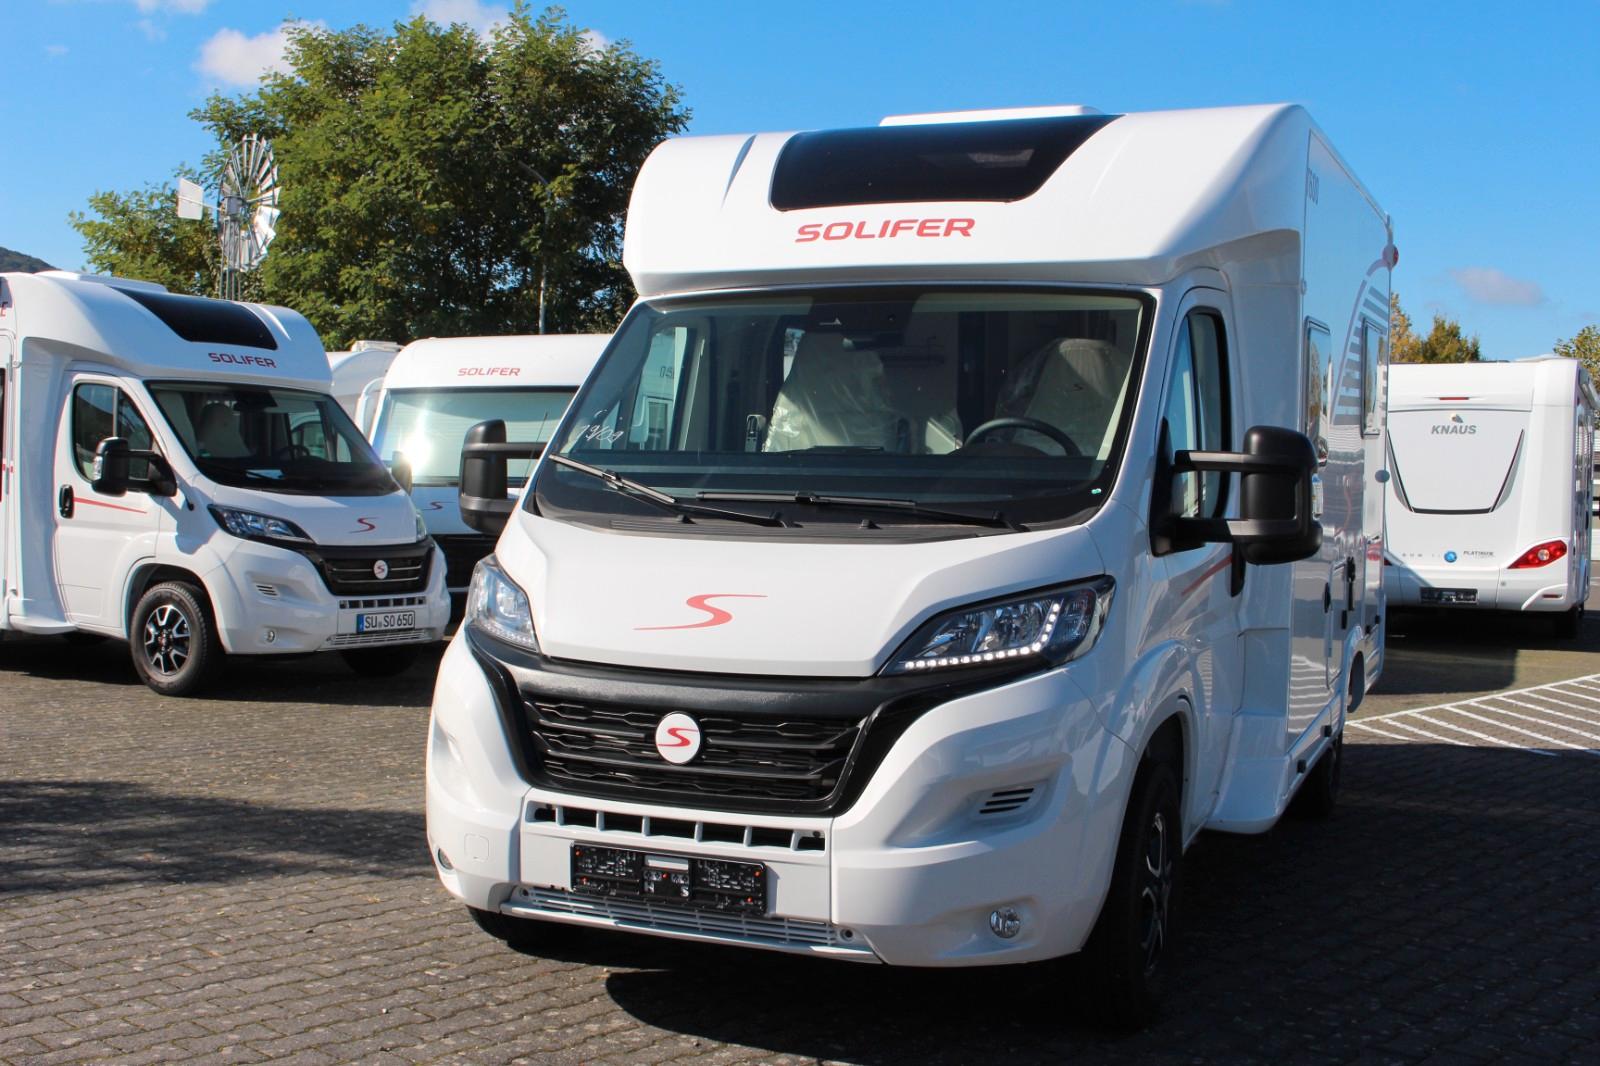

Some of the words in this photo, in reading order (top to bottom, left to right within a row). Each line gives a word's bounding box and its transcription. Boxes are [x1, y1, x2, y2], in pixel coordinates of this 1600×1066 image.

[795, 218, 976, 243] SOLIFER
[207, 352, 277, 369] SOLIFER
[457, 367, 521, 377] SOLIFER
[1431, 424, 1477, 435] KNAUS
[365, 615, 378, 629] SU
[383, 614, 396, 628] SO
[397, 613, 414, 627] 650
